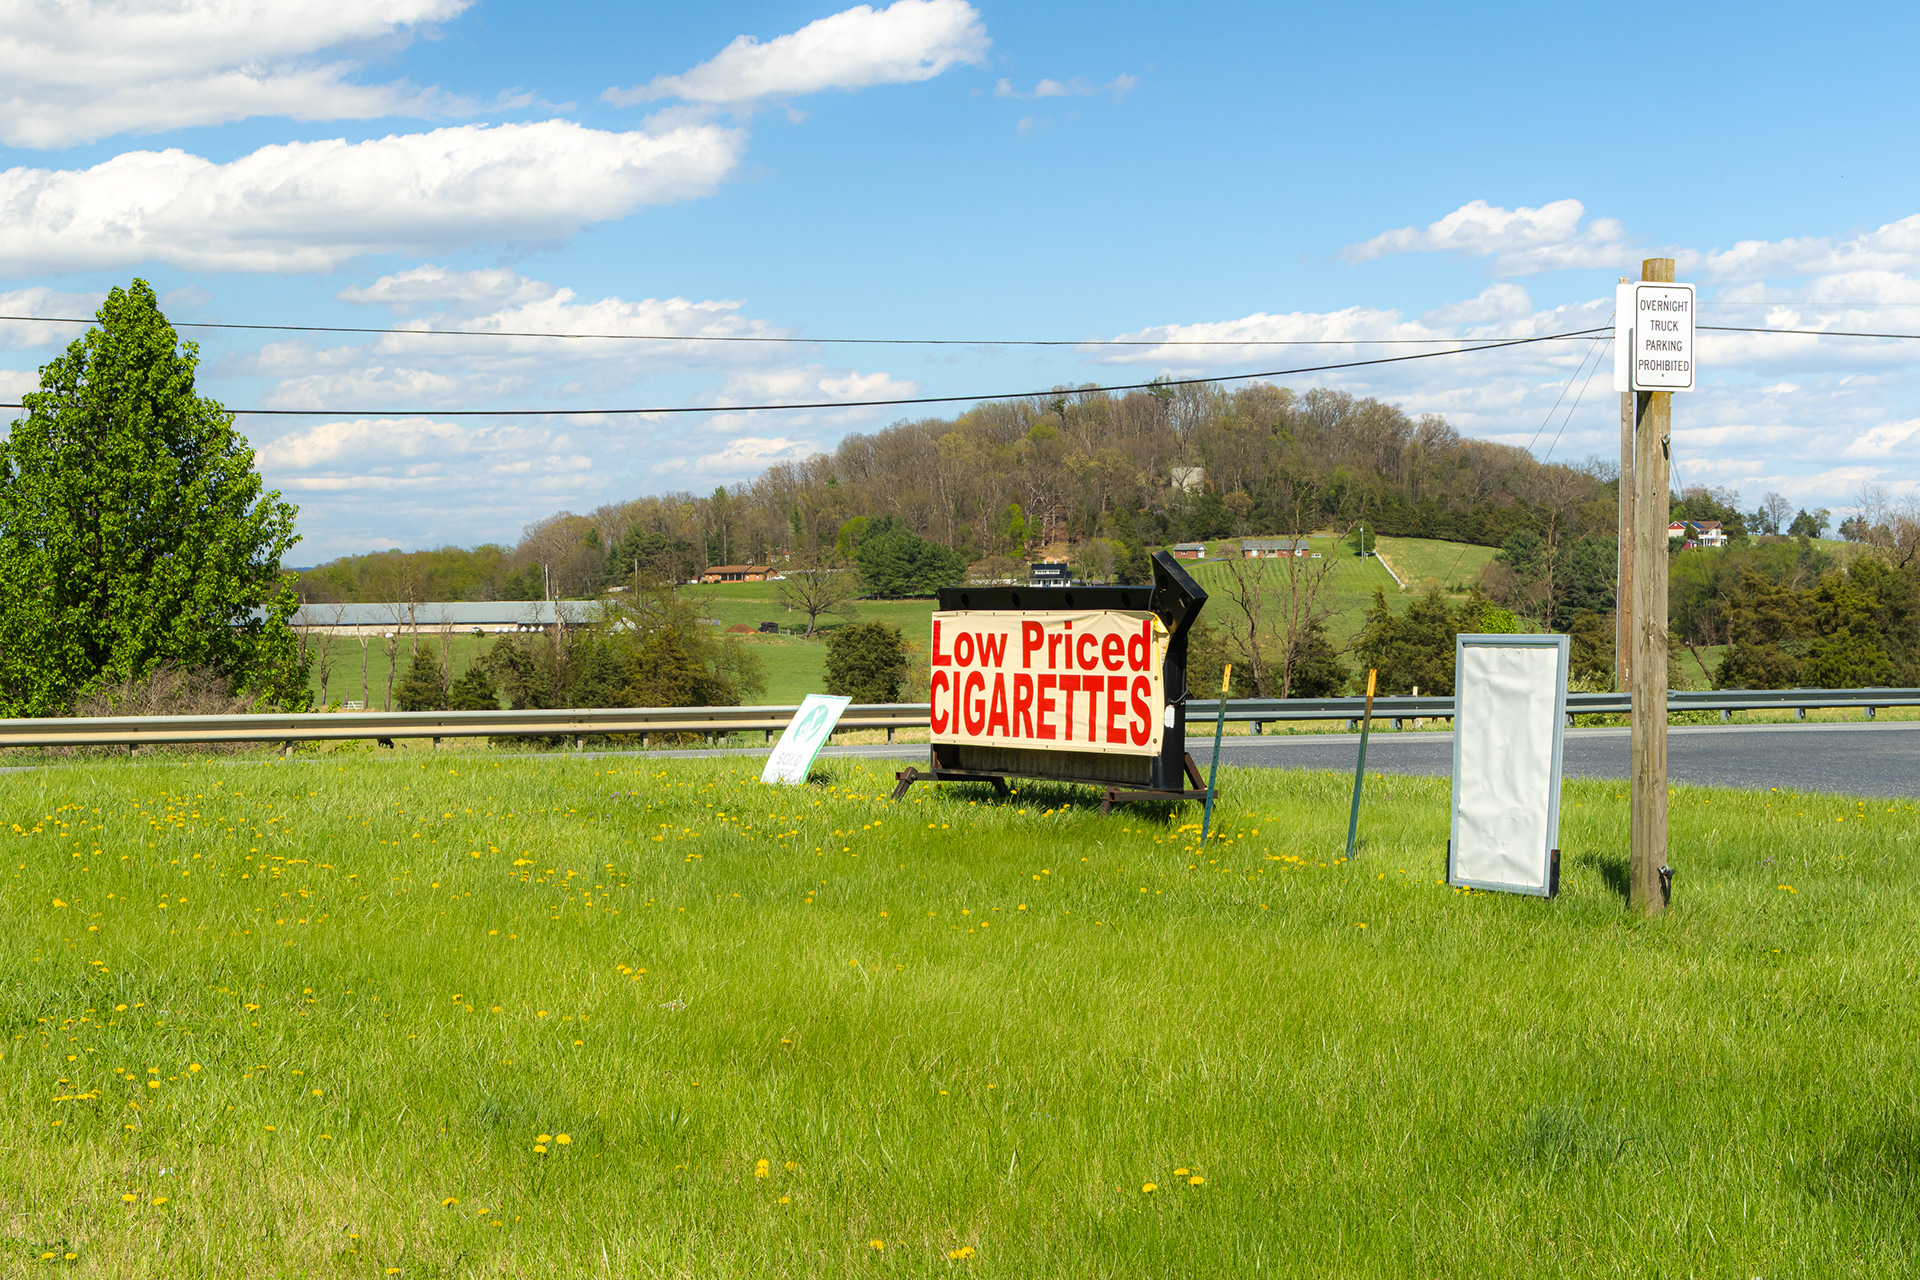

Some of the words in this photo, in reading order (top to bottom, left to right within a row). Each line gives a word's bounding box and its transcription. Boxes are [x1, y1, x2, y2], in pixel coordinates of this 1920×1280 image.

[1640, 300, 1688, 312] OVERNIGHT
[1650, 320, 1678, 331] TRUCK
[1646, 340, 1682, 351] PARKING
[1638, 359, 1689, 371] PROHIBITED
[931, 620, 1008, 668] Low
[1021, 620, 1151, 672] Priced
[930, 669, 1152, 747] CIGARETTES
[776, 752, 803, 767] SOLD
